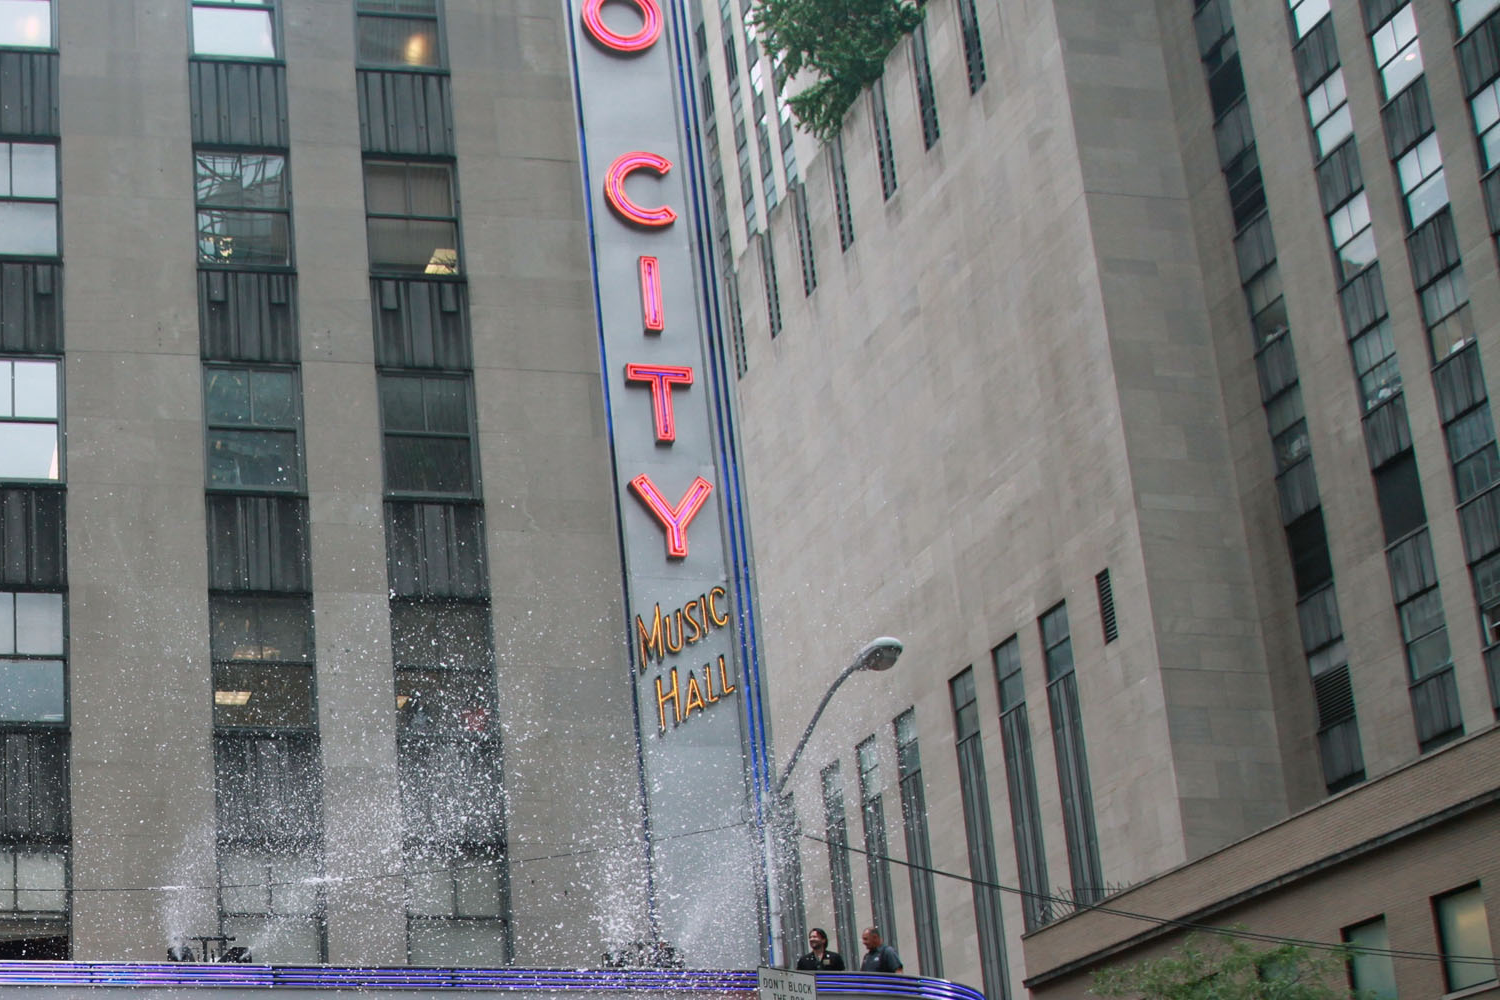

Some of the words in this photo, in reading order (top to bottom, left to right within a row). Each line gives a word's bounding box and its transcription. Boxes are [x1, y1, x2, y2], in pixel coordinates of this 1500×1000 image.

[604, 151, 714, 559] CITY
[763, 978, 784, 990] DON'T
[789, 981, 813, 995] BLOCK
